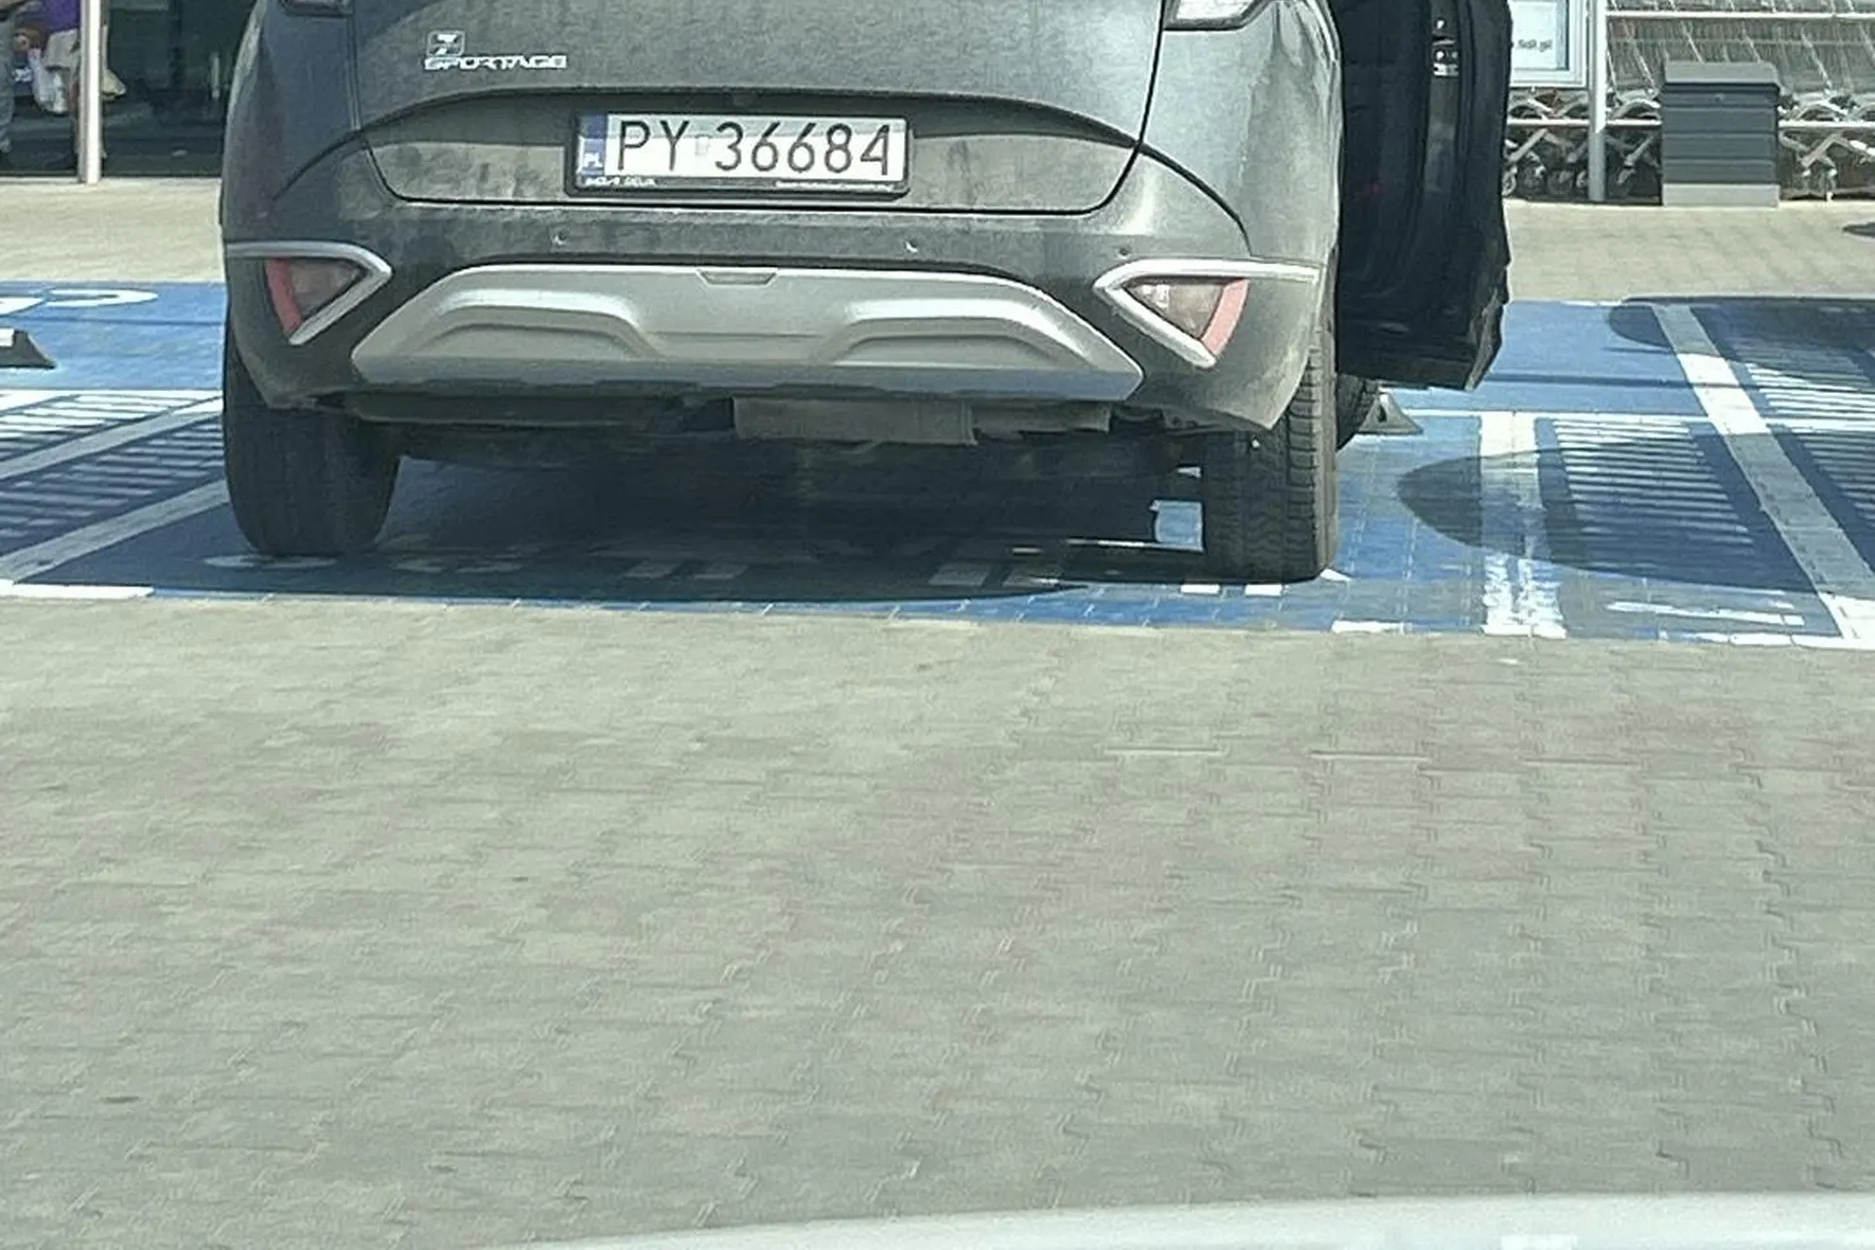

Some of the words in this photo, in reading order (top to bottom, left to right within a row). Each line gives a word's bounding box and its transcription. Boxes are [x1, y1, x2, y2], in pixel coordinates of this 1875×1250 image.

[424, 54, 568, 71] SPORTAGE
[617, 119, 690, 172] PY
[714, 121, 891, 176] 36684
